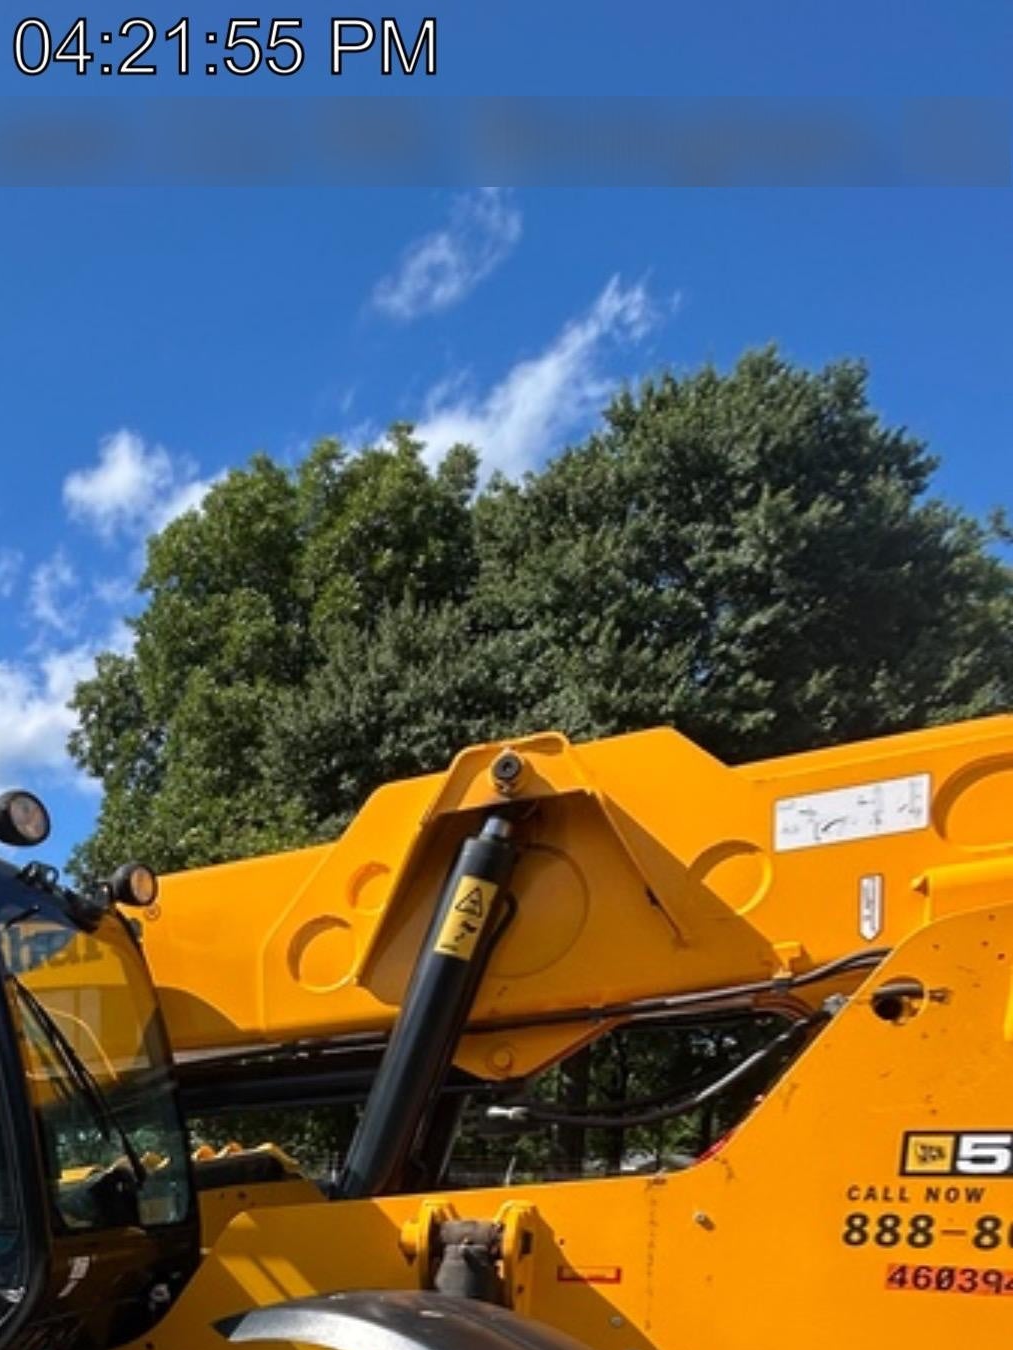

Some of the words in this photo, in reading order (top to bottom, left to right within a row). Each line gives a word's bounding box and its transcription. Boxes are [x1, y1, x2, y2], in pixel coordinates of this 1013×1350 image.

[846, 1184, 910, 1202] CALL
[925, 1186, 986, 1203] NOW
[843, 1212, 1013, 1250] 888-8
